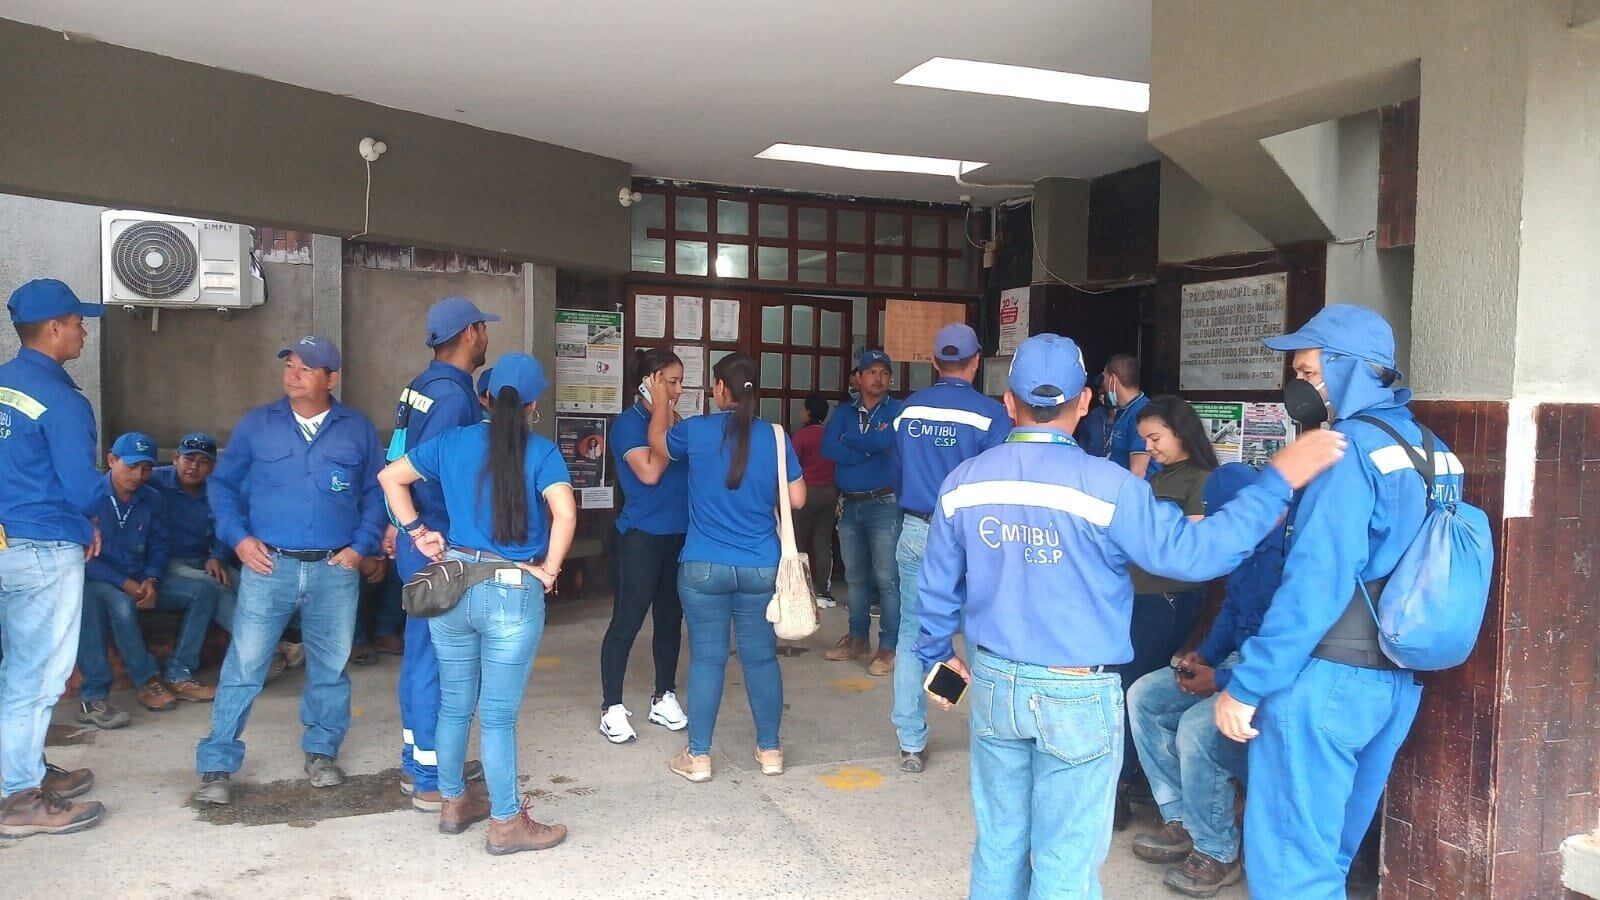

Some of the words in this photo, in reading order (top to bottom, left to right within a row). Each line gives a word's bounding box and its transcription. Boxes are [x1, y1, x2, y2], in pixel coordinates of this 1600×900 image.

[203, 223, 232, 232] SIMPLY
[907, 419, 957, 438] EMTIBÚ
[979, 516, 1060, 549] EMTIBÚ
[1024, 549, 1063, 564] E.S.P
